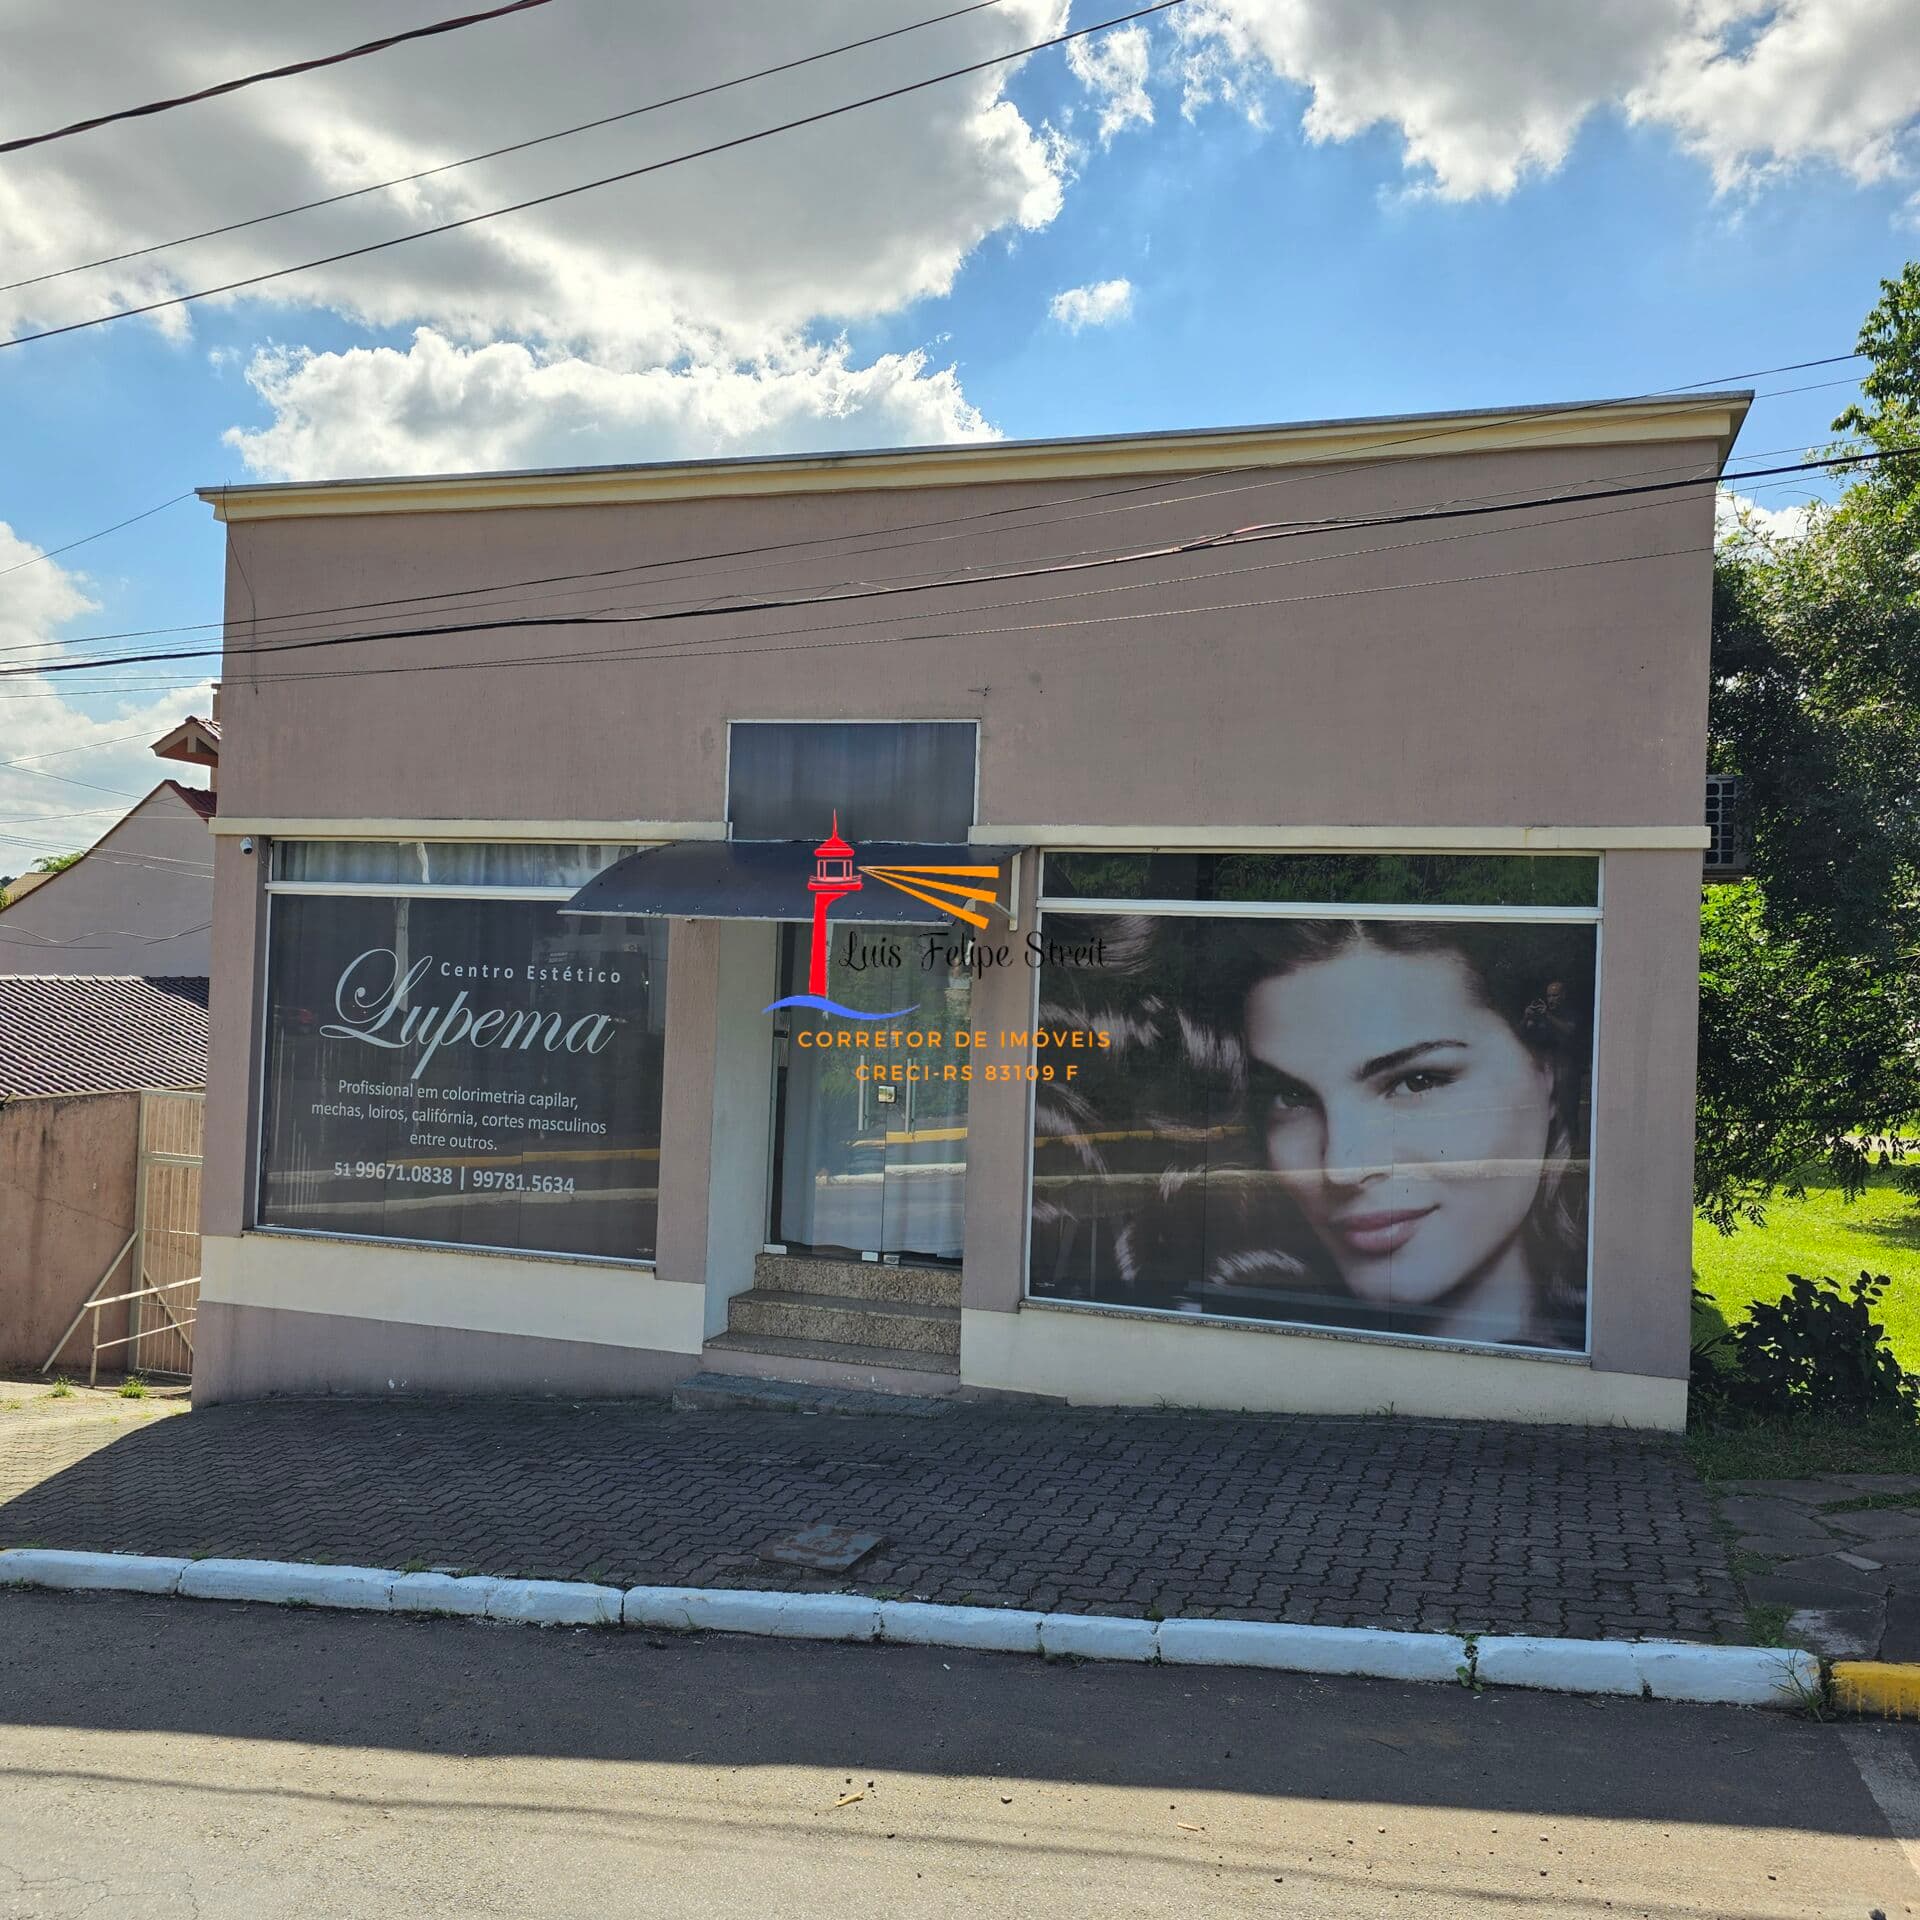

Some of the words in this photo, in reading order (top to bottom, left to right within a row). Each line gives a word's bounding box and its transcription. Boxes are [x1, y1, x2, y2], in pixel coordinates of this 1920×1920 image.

[440, 961, 515, 980] Centro
[526, 964, 622, 984] Estético
[319, 948, 617, 1080] Lupema
[338, 1079, 414, 1098] Profissional
[417, 1087, 439, 1099] em
[442, 1086, 526, 1105] colorimetria
[529, 1092, 579, 1110] capilar,
[311, 1102, 365, 1120] mechas,
[368, 1104, 408, 1123] loiros,
[412, 1107, 478, 1128] califórnia,
[481, 1114, 525, 1129] cortes
[527, 1117, 607, 1134] masculinos
[409, 1133, 446, 1147] entre
[449, 1135, 498, 1151] outros.
[333, 1161, 351, 1177] 51
[355, 1160, 453, 1185] 99671.0838
[472, 1169, 576, 1194] 99781.5634
